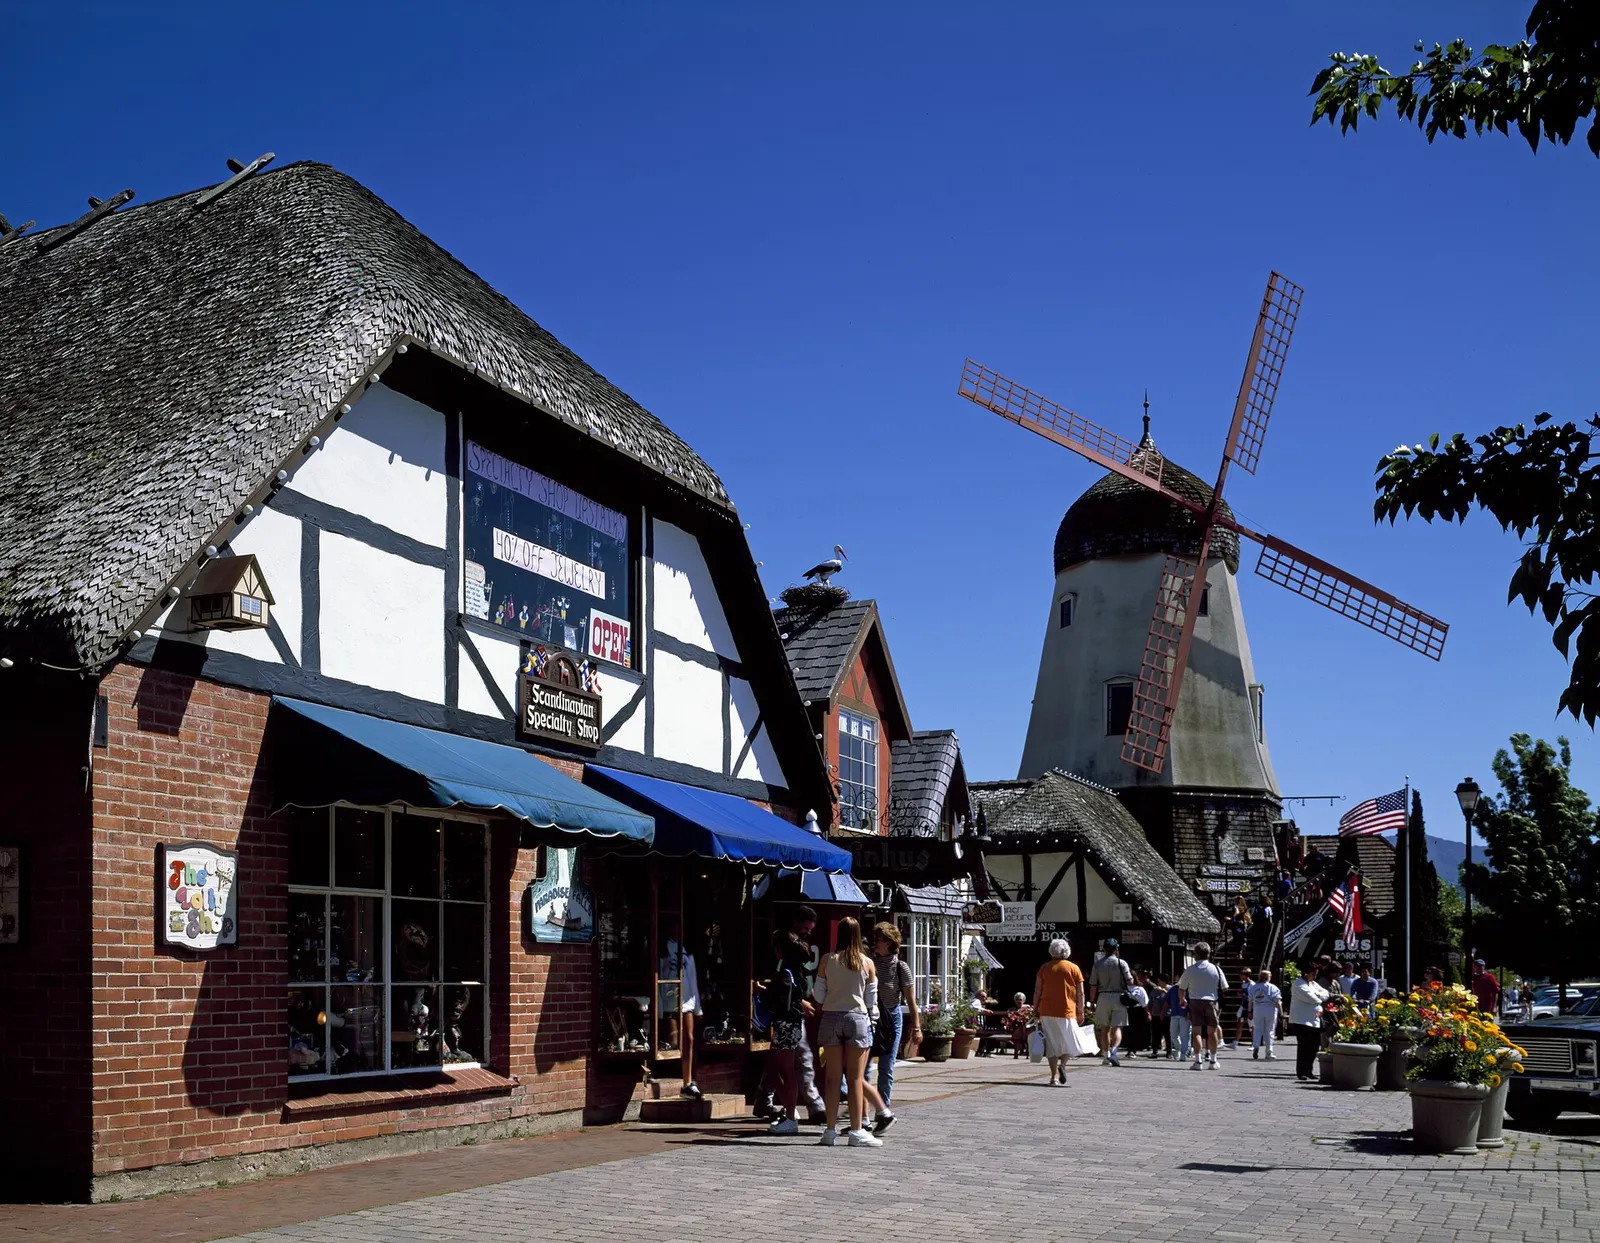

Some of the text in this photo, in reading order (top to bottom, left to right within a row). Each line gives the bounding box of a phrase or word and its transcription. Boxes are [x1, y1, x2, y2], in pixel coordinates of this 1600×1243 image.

[469, 443, 627, 540] SPECIALTY SHOP UPSTAIRS
[522, 538, 546, 568] OFF
[551, 551, 603, 595] JEWELRY
[592, 616, 628, 664] OPEN
[532, 683, 594, 718] Scandinavian
[527, 704, 599, 742] Specialty Shop
[169, 860, 208, 890] The
[1206, 880, 1241, 891] SWEAERS
[535, 886, 592, 917] PARADISE FALLS
[186, 909, 234, 939] Shop
[1041, 931, 1070, 942] BOX
[1334, 939, 1371, 951] BUS
[1335, 952, 1370, 960] PARKNG
